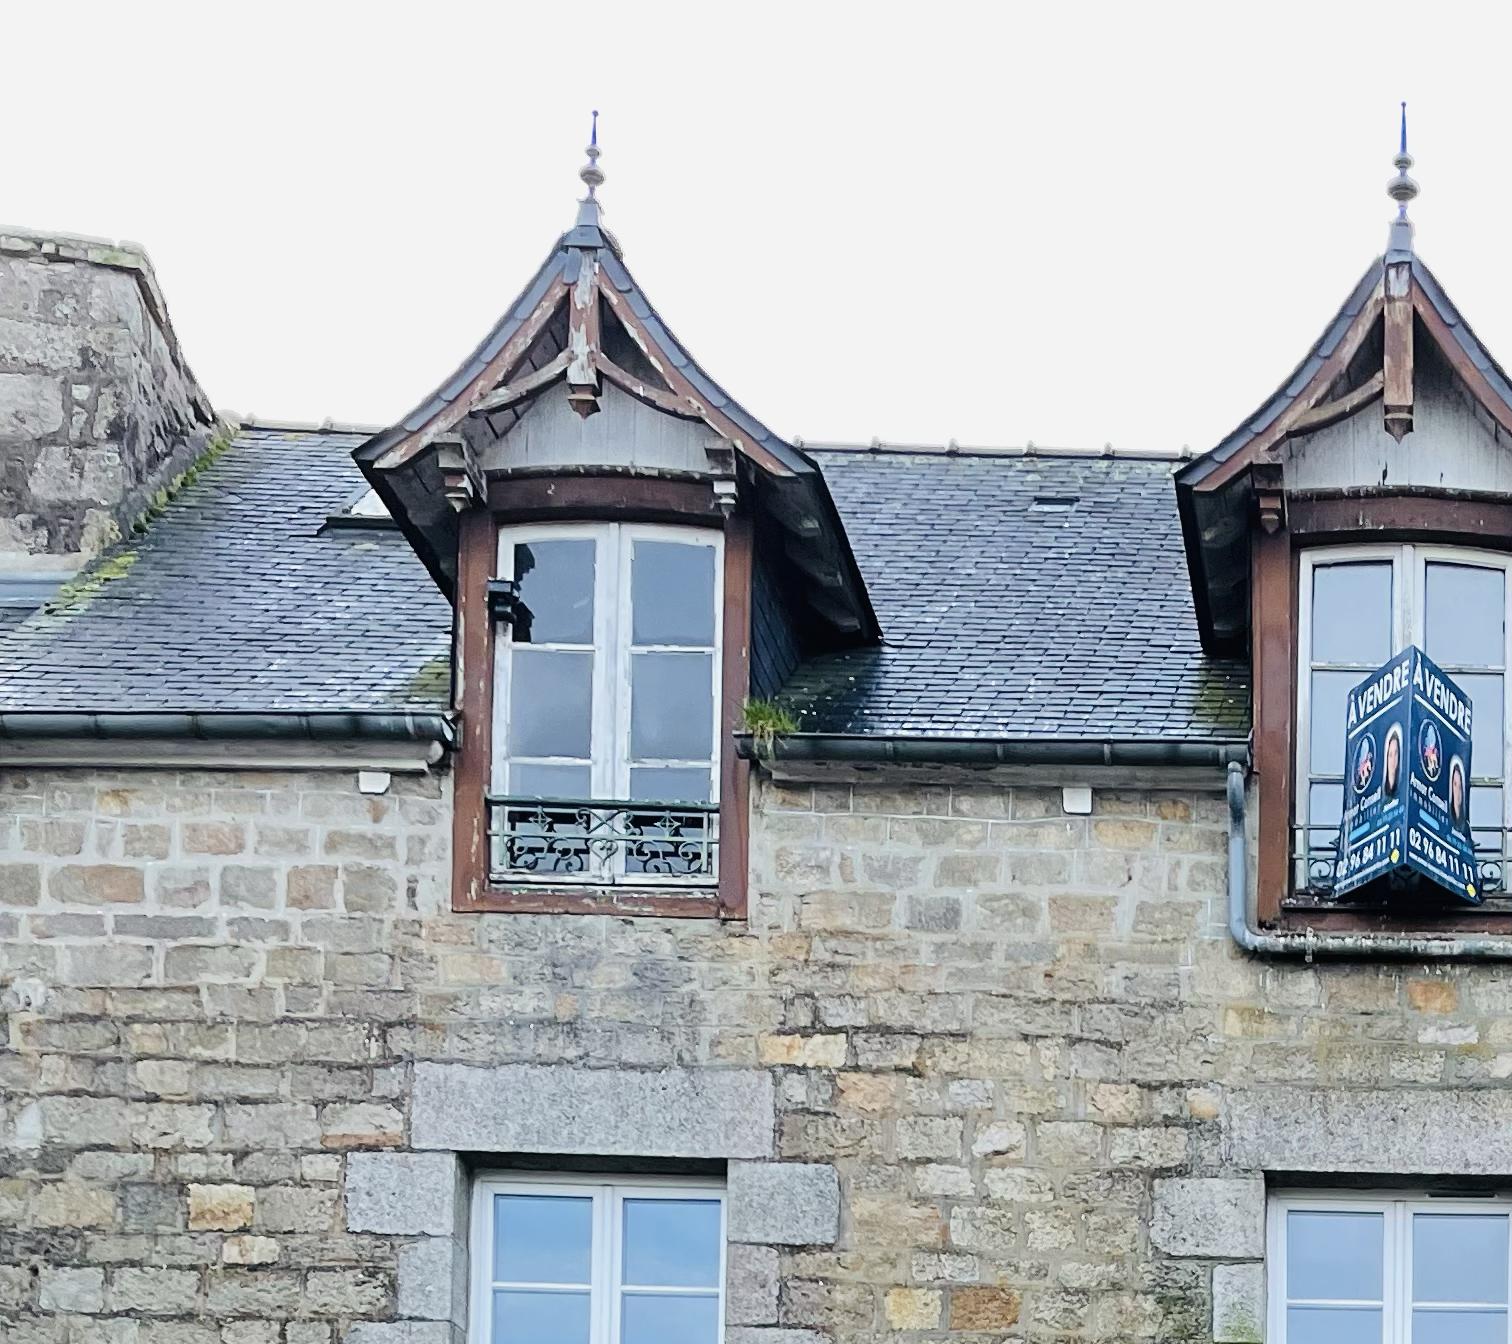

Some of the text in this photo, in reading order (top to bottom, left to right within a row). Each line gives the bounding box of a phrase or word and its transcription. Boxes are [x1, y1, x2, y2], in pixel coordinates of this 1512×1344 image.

[1347, 659, 1410, 730] À VENDRE
[1413, 652, 1472, 736] À VENDRE
[1377, 836, 1387, 856] 11
[1390, 828, 1400, 849] 11
[1409, 827, 1421, 851] 02
[1423, 837, 1434, 859] 96
[1435, 845, 1447, 868] 84
[1448, 854, 1460, 875] 11
[1462, 862, 1474, 882] 11
